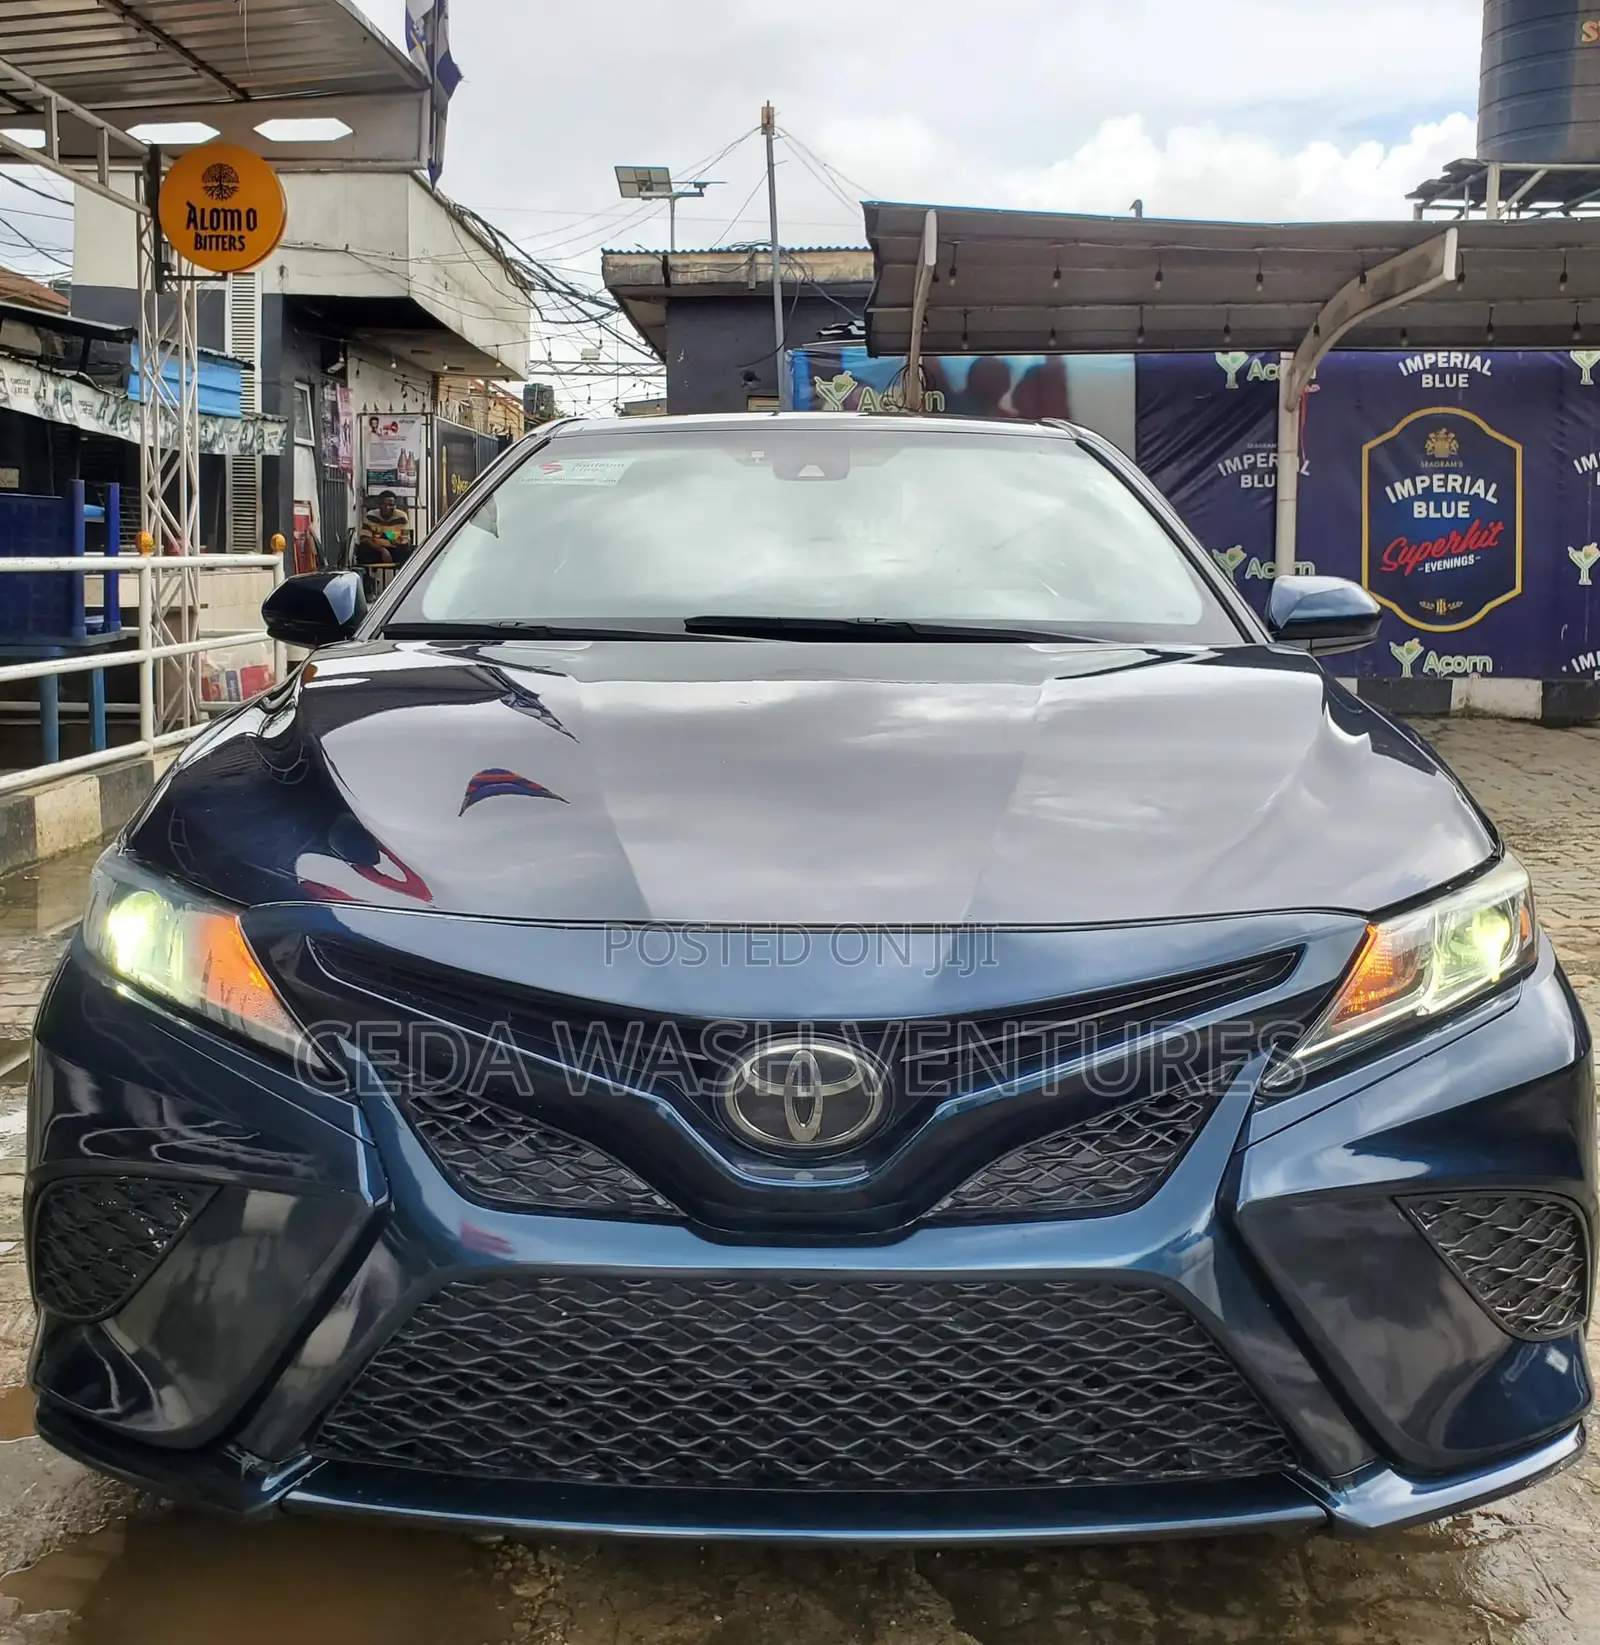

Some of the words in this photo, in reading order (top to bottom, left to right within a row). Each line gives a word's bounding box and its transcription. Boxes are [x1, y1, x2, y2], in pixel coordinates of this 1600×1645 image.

[186, 200, 257, 231] ALOMO
[194, 231, 246, 252] BITTERS
[1398, 351, 1492, 377] IMPERIAL
[1421, 373, 1469, 388] BLUE
[1240, 474, 1276, 488] BLU
[1384, 474, 1499, 504] IMPERIAL
[1413, 501, 1470, 519] BLUE
[1380, 518, 1505, 577] Superhit
[1422, 650, 1493, 674] Acorn
